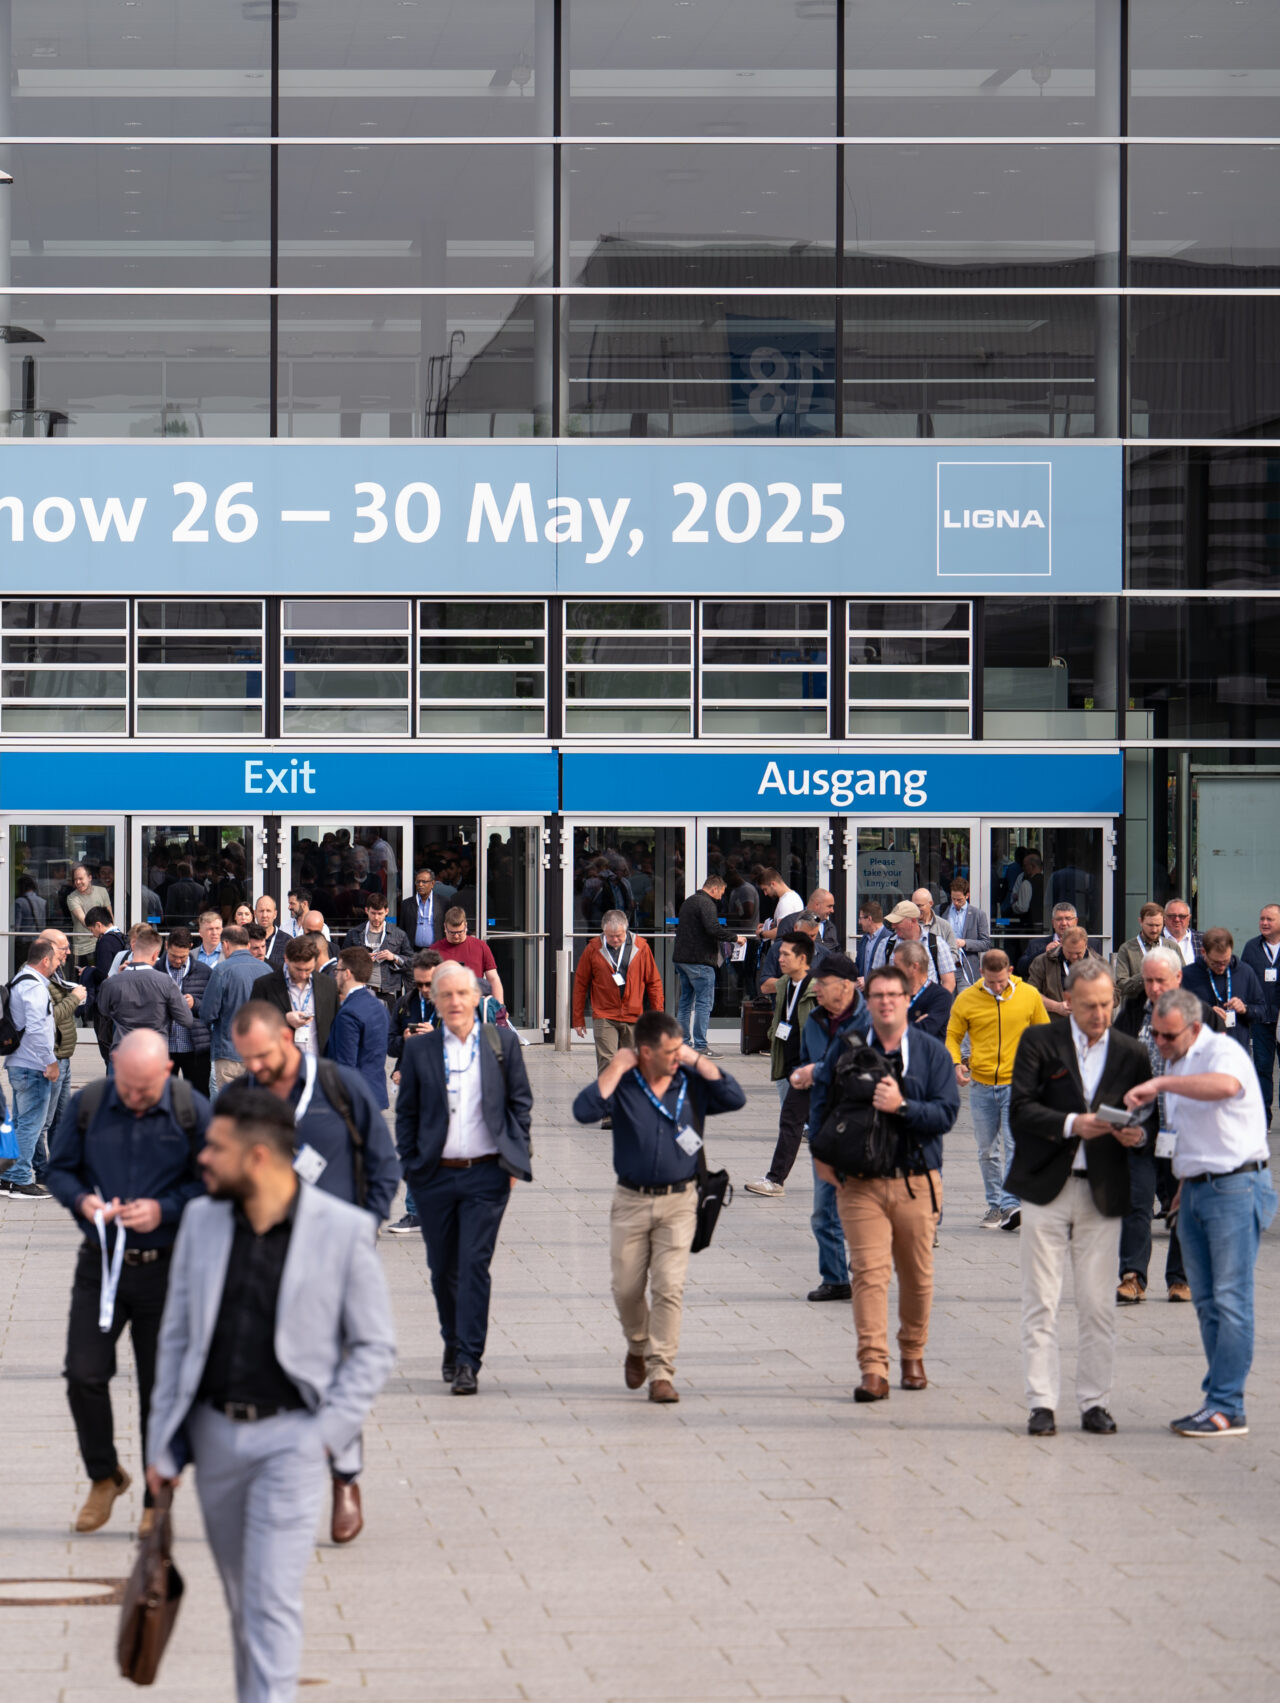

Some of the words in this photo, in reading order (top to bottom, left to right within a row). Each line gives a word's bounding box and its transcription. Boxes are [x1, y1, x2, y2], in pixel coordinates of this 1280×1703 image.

[171, 481, 259, 544] 26
[353, 481, 441, 544] 30
[466, 482, 644, 564] May,
[671, 481, 845, 544] 2025
[943, 509, 1045, 529] LIGNA
[244, 759, 317, 794] Exit
[757, 760, 928, 807] Ausgang
[863, 868, 882, 877] take
[883, 870, 903, 878] your
[869, 857, 896, 866] Please
